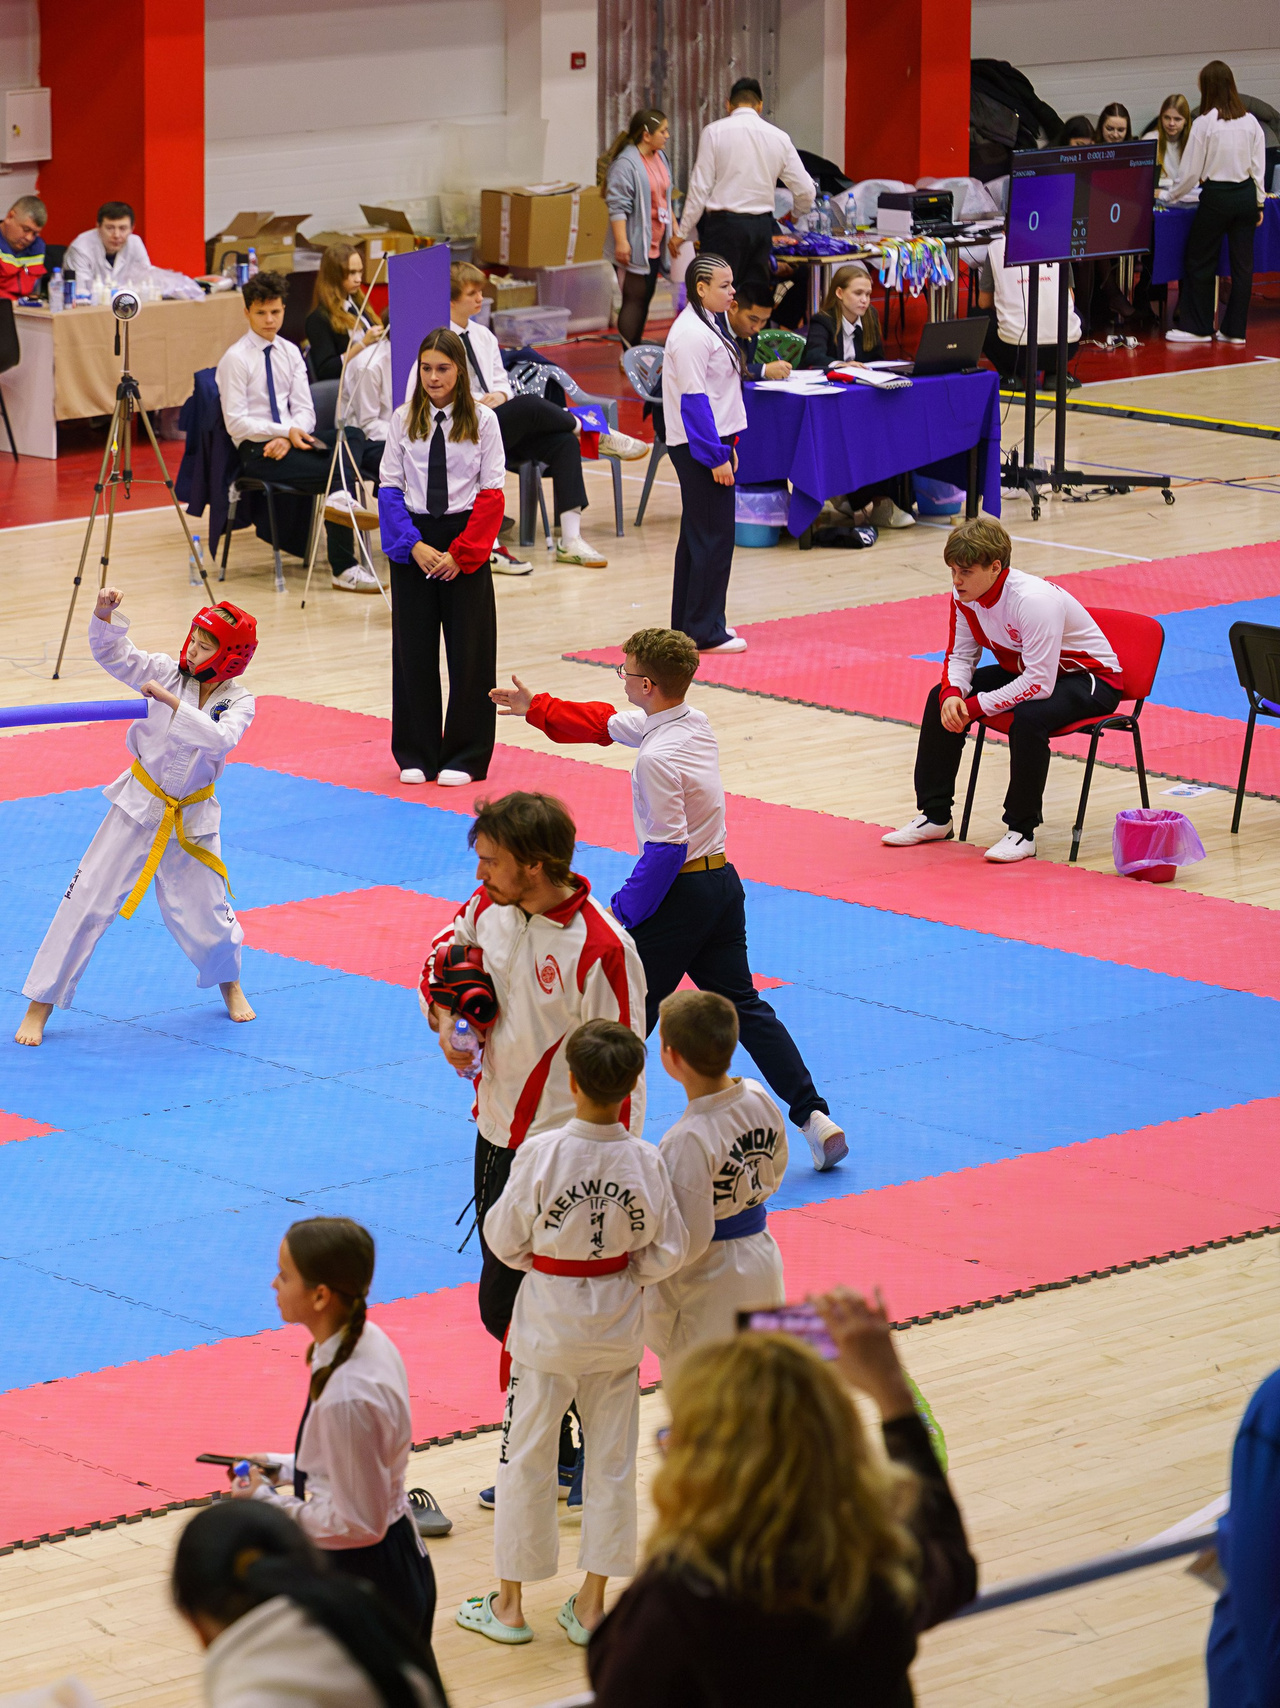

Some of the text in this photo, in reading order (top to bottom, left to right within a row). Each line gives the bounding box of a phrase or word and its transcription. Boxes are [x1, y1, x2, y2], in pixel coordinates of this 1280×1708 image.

[1028, 211, 1039, 232] 0
[1110, 203, 1121, 224] 0
[1073, 227, 1086, 238] 0 0
[544, 1179, 645, 1232] TAEKWON-DO
[590, 1197, 609, 1210] ITF
